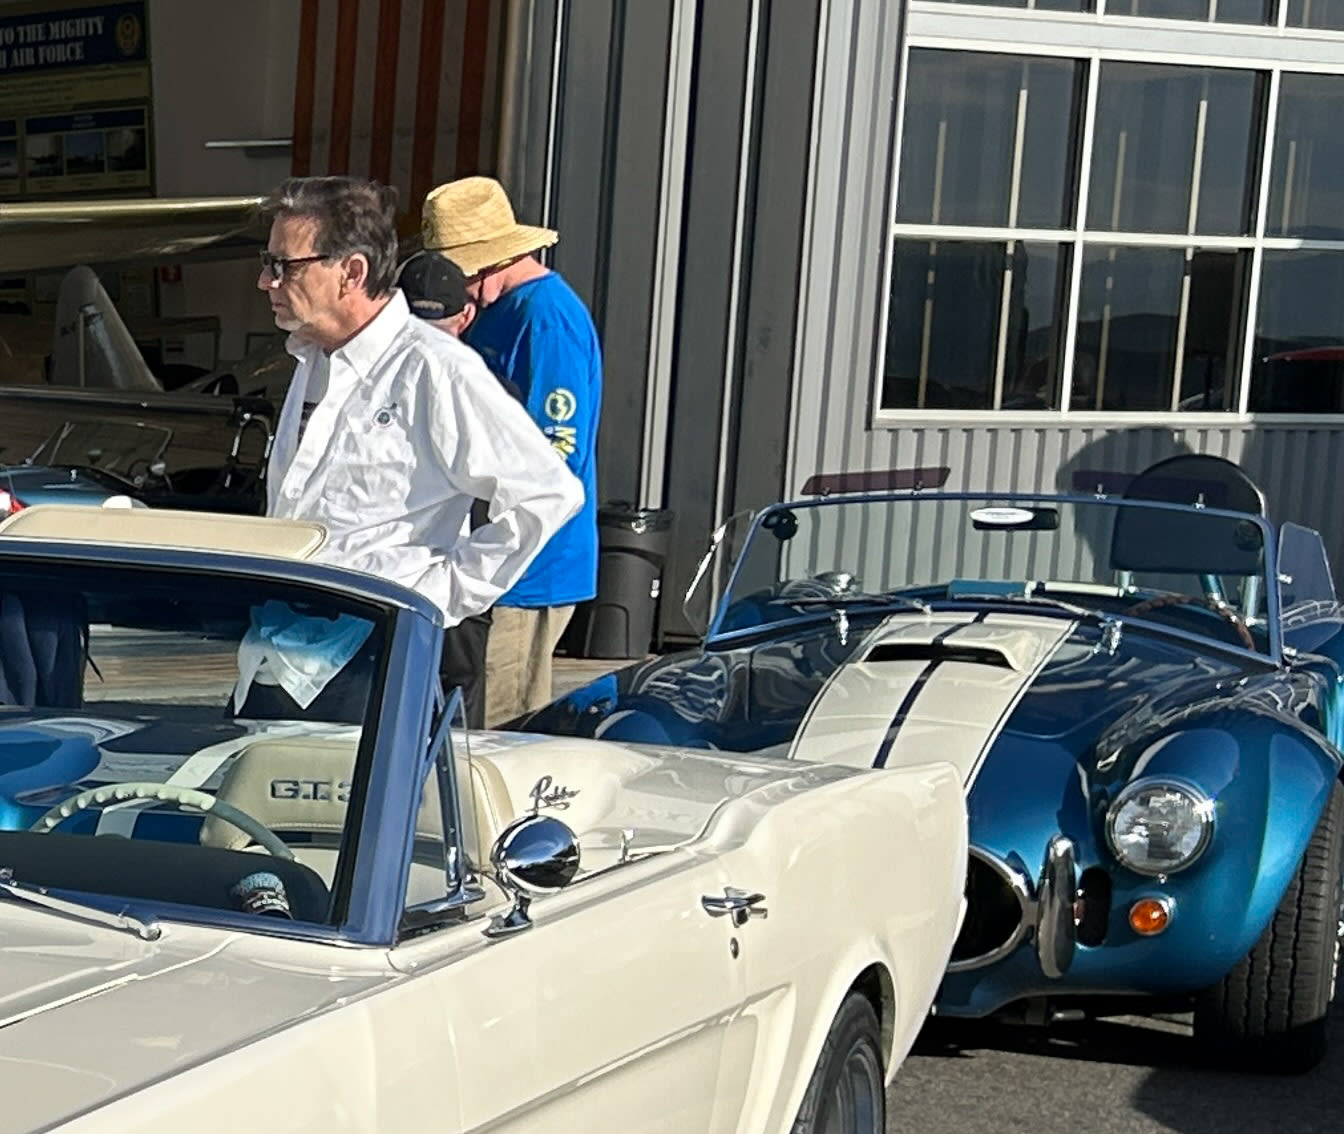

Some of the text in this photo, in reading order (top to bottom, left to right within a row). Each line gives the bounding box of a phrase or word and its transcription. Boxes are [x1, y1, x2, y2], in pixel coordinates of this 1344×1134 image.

[16, 22, 47, 44] THE
[49, 16, 105, 41] MIGHTY
[10, 46, 35, 68] AIR
[39, 41, 85, 65] FORCE
